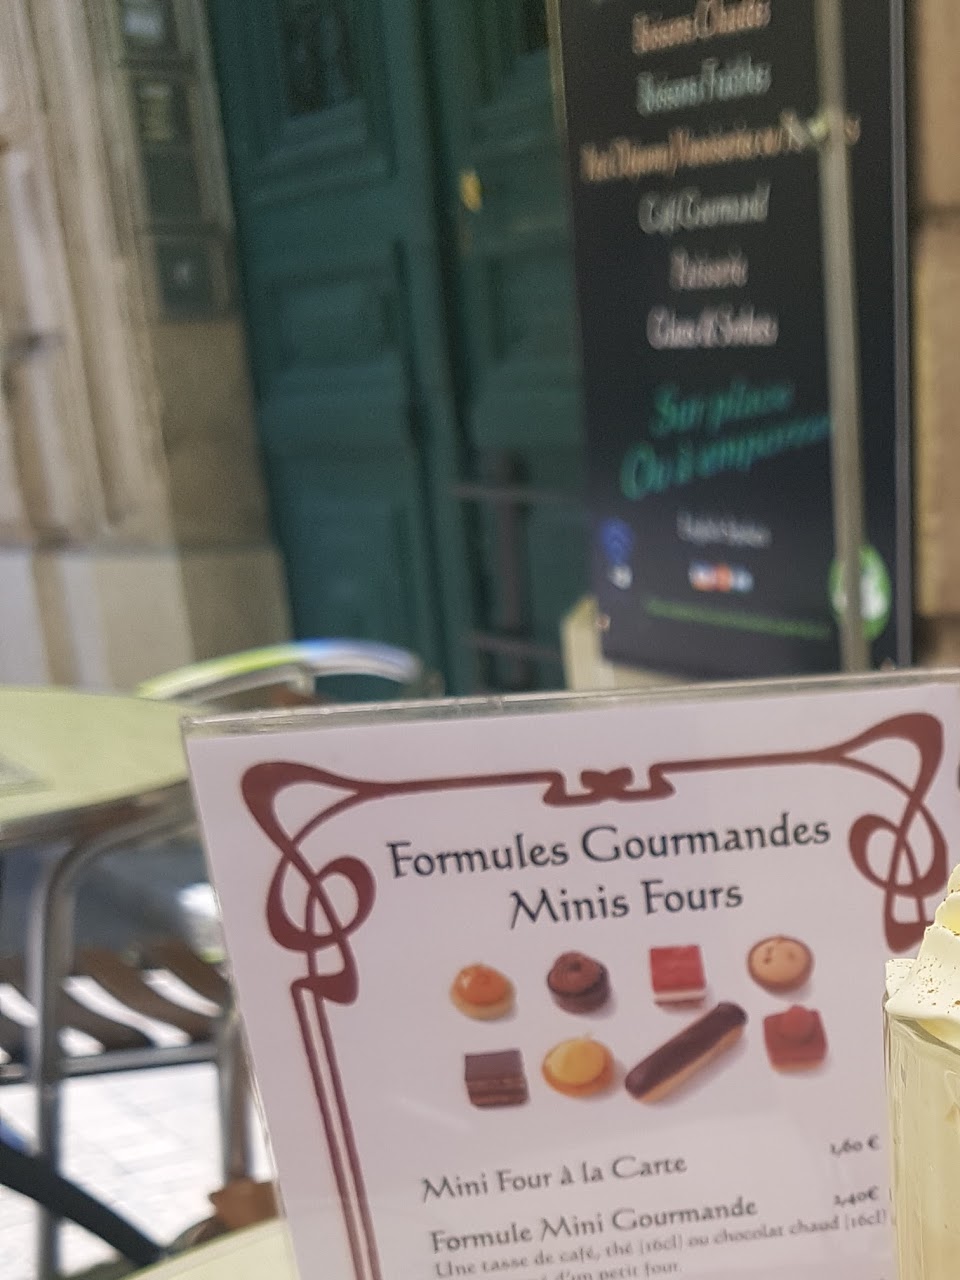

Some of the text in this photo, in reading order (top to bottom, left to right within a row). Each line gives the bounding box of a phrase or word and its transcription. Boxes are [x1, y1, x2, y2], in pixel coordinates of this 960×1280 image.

[385, 811, 831, 879] Formules Gourmandes
[510, 878, 744, 930] Minis Fours
[421, 1155, 687, 1204] Mini Four à la Carte
[429, 1196, 758, 1254] Formule Mini Gourmande
[435, 1260, 476, 1279] Une
[483, 1255, 529, 1274] tasse
[534, 1250, 554, 1267] de
[560, 1246, 601, 1265] café,
[606, 1240, 632, 1258] thé
[688, 1235, 709, 1249] ou
[713, 1223, 784, 1245] chocolat
[789, 1214, 839, 1236] chaud
